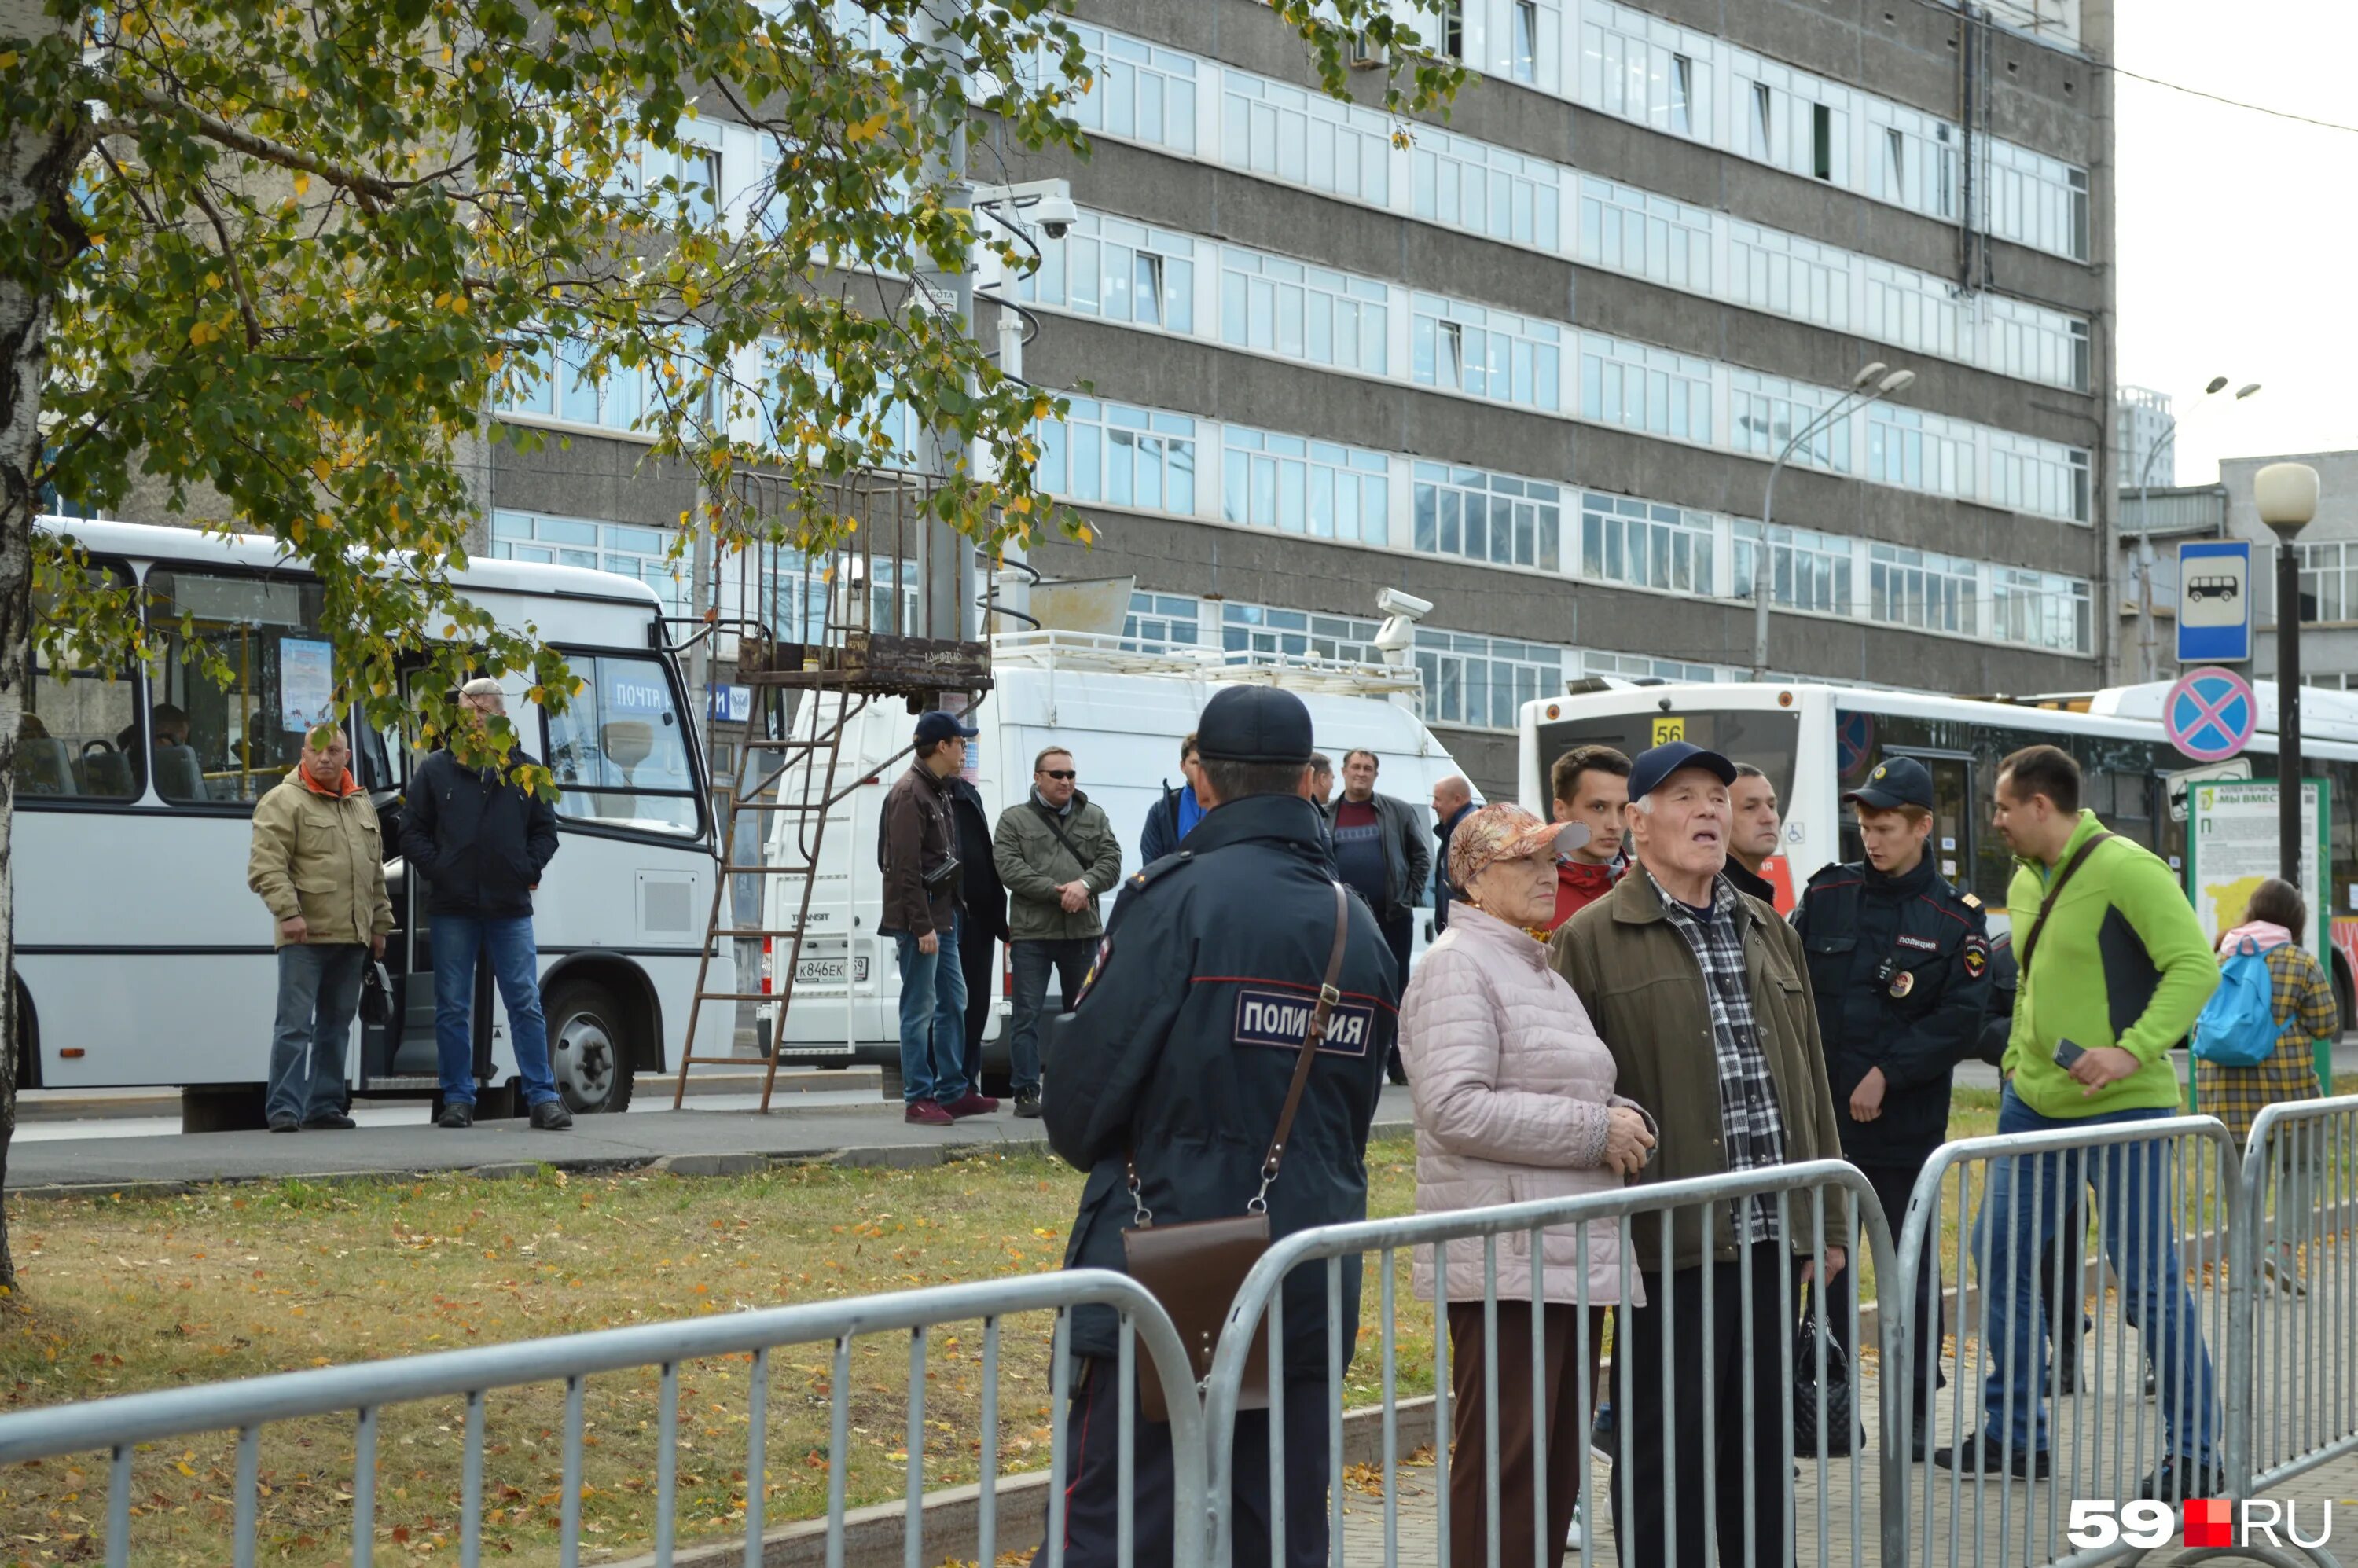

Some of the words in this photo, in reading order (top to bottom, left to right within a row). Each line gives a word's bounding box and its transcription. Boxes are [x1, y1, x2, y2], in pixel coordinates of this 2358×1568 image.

[616, 683, 661, 709] ПОЧТА
[1656, 725, 1680, 745] 56
[2242, 793, 2278, 803] ВМЕС
[1899, 936, 1937, 949] ПОЛИЦИЯ
[799, 961, 843, 976] К846ЕК
